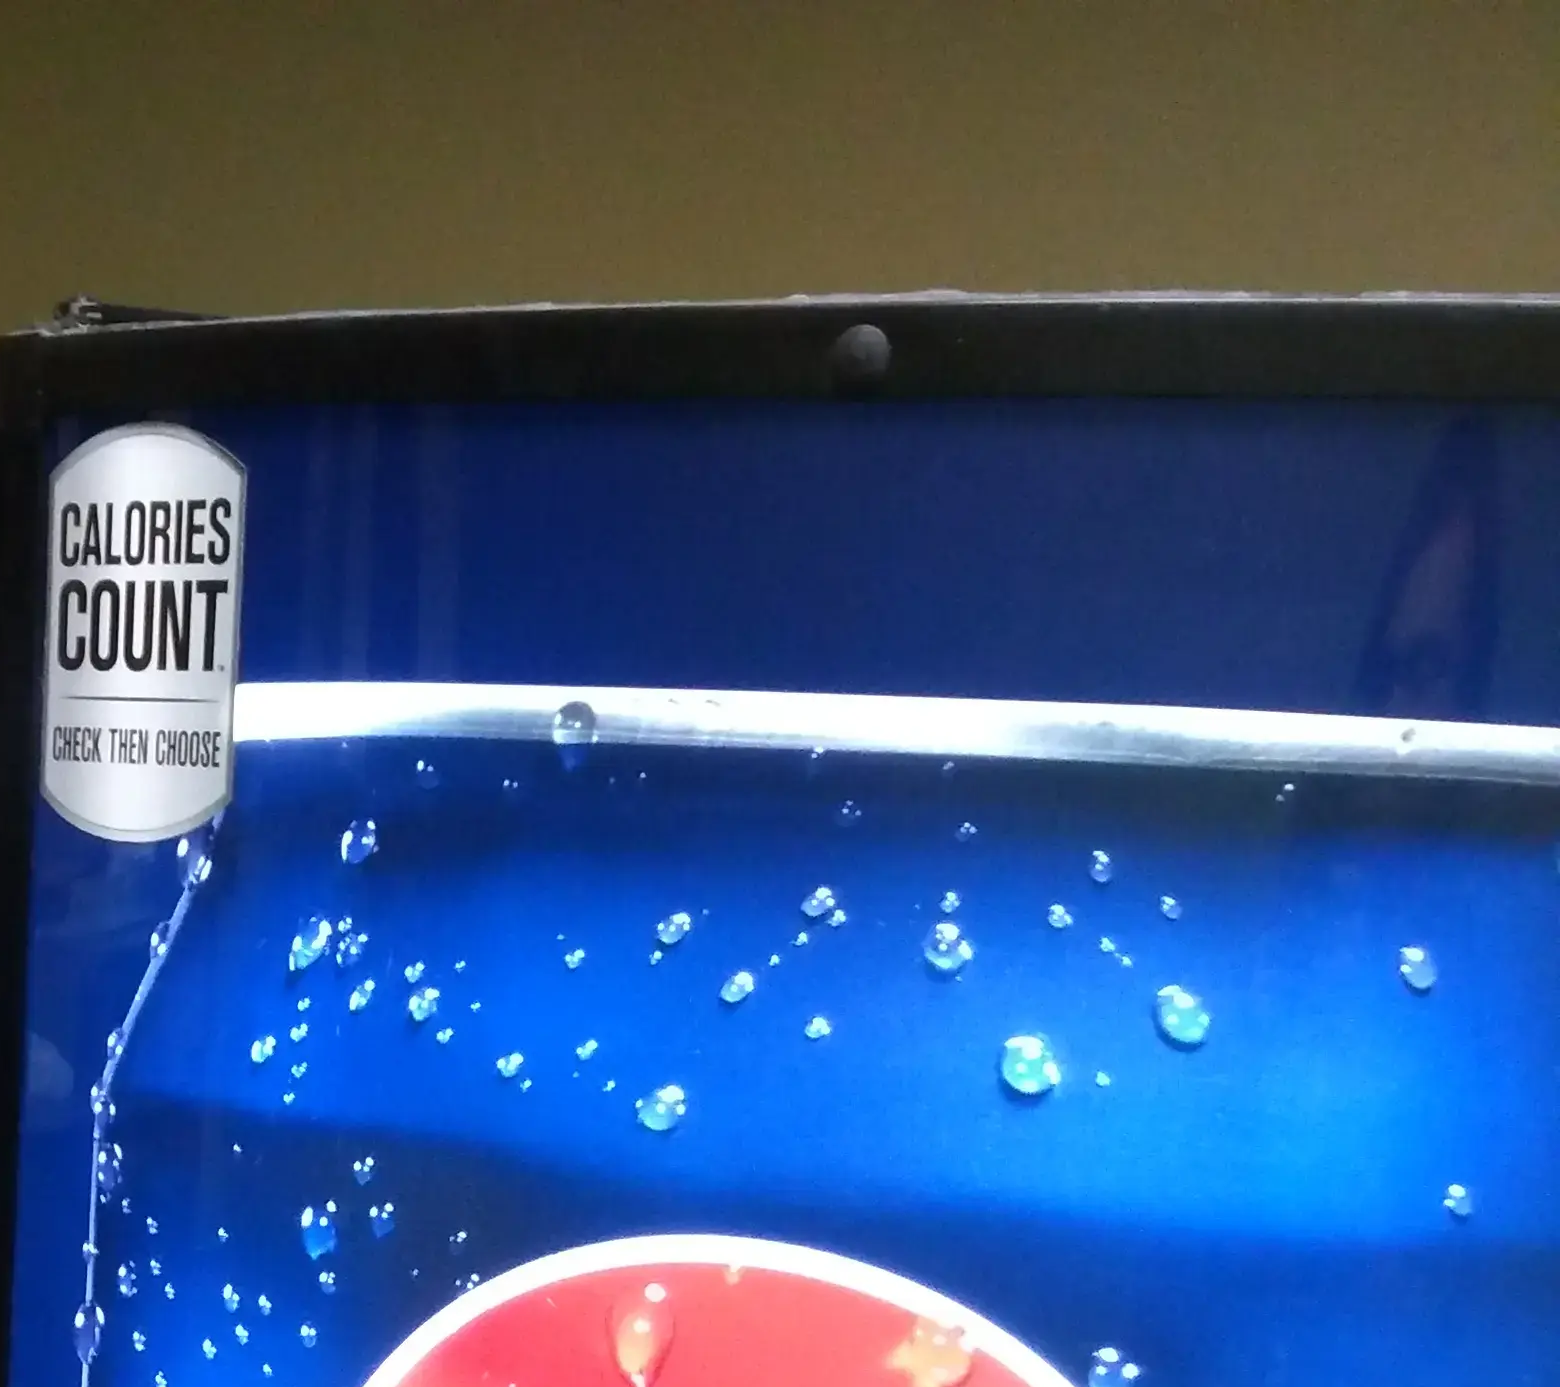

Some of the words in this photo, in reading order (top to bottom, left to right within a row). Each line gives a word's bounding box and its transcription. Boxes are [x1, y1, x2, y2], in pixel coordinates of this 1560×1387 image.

[60, 497, 231, 567] CALORIES
[57, 578, 229, 672] COUNT
[52, 726, 101, 763] CHECK
[108, 728, 148, 765] THEN
[155, 729, 221, 768] CHOOSE
